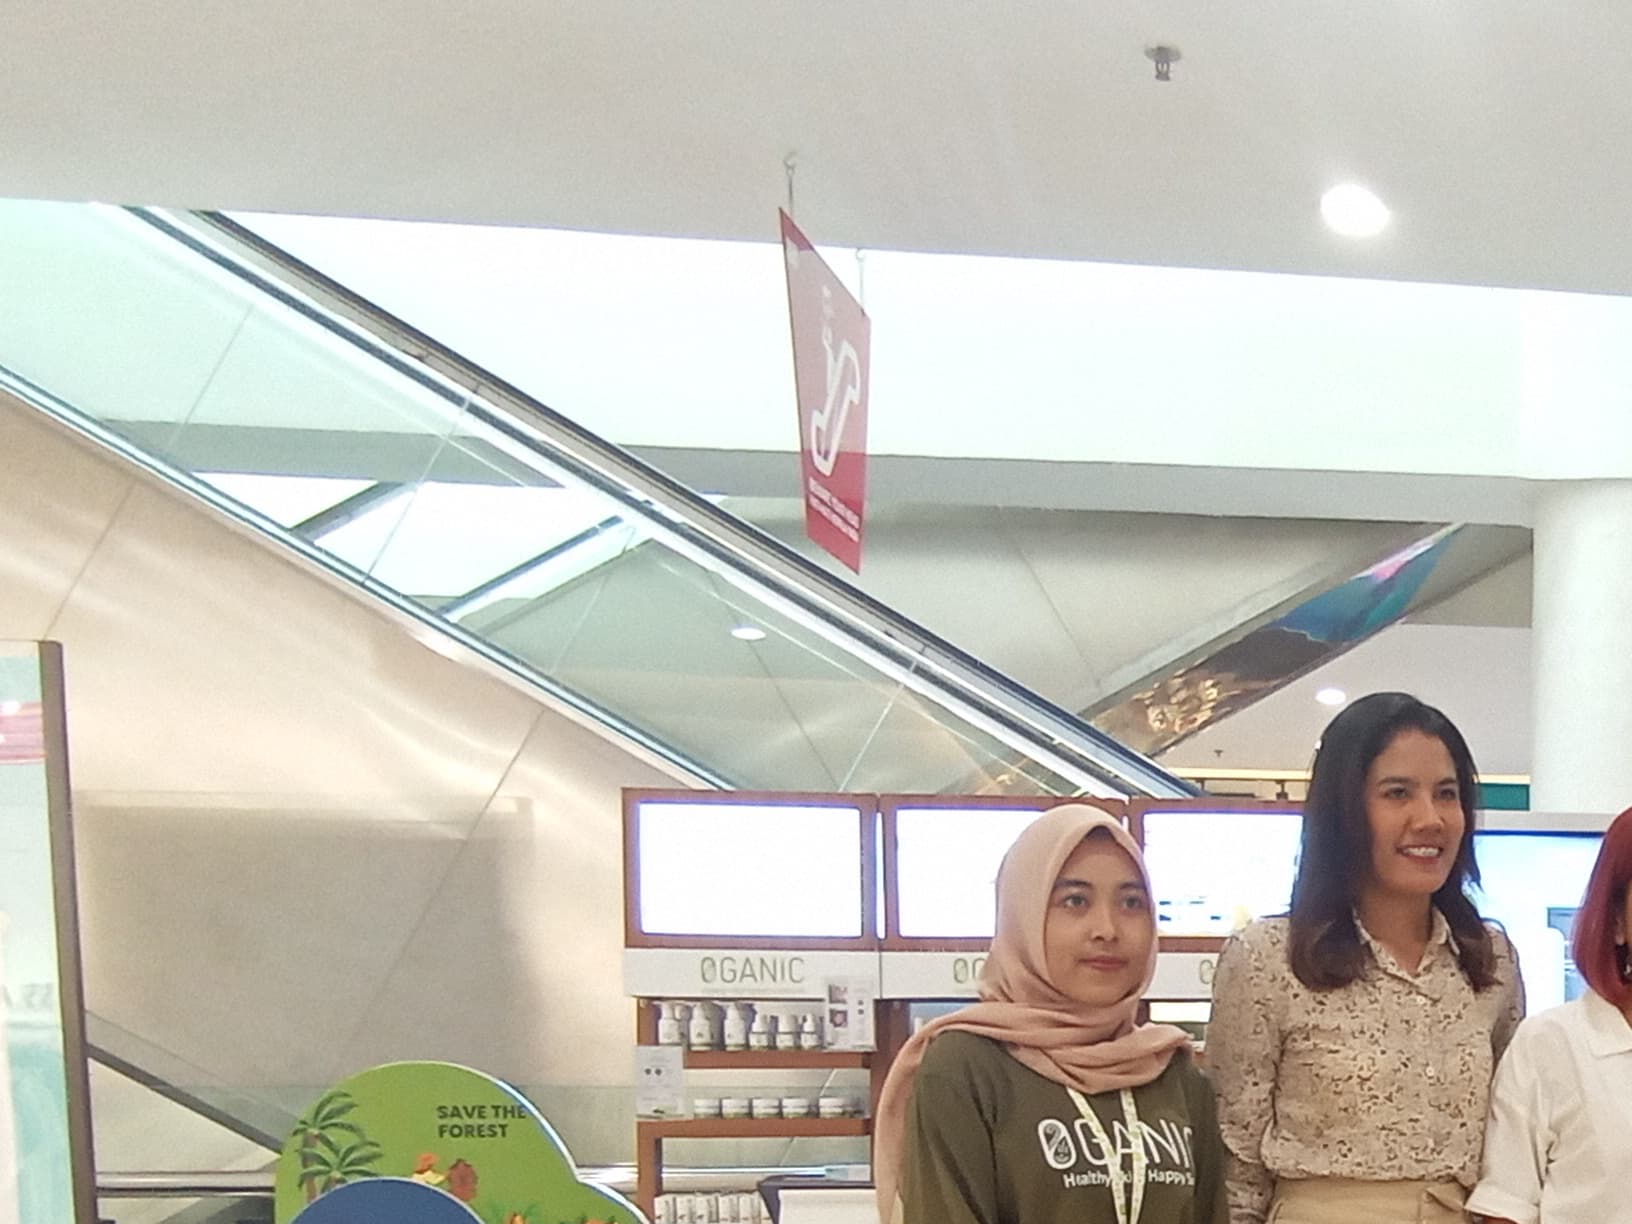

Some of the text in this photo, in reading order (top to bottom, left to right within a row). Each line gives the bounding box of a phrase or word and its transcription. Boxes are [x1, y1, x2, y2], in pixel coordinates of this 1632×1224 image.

[437, 1104, 527, 1121] SAVE THE
[438, 1124, 508, 1139] FOREST
